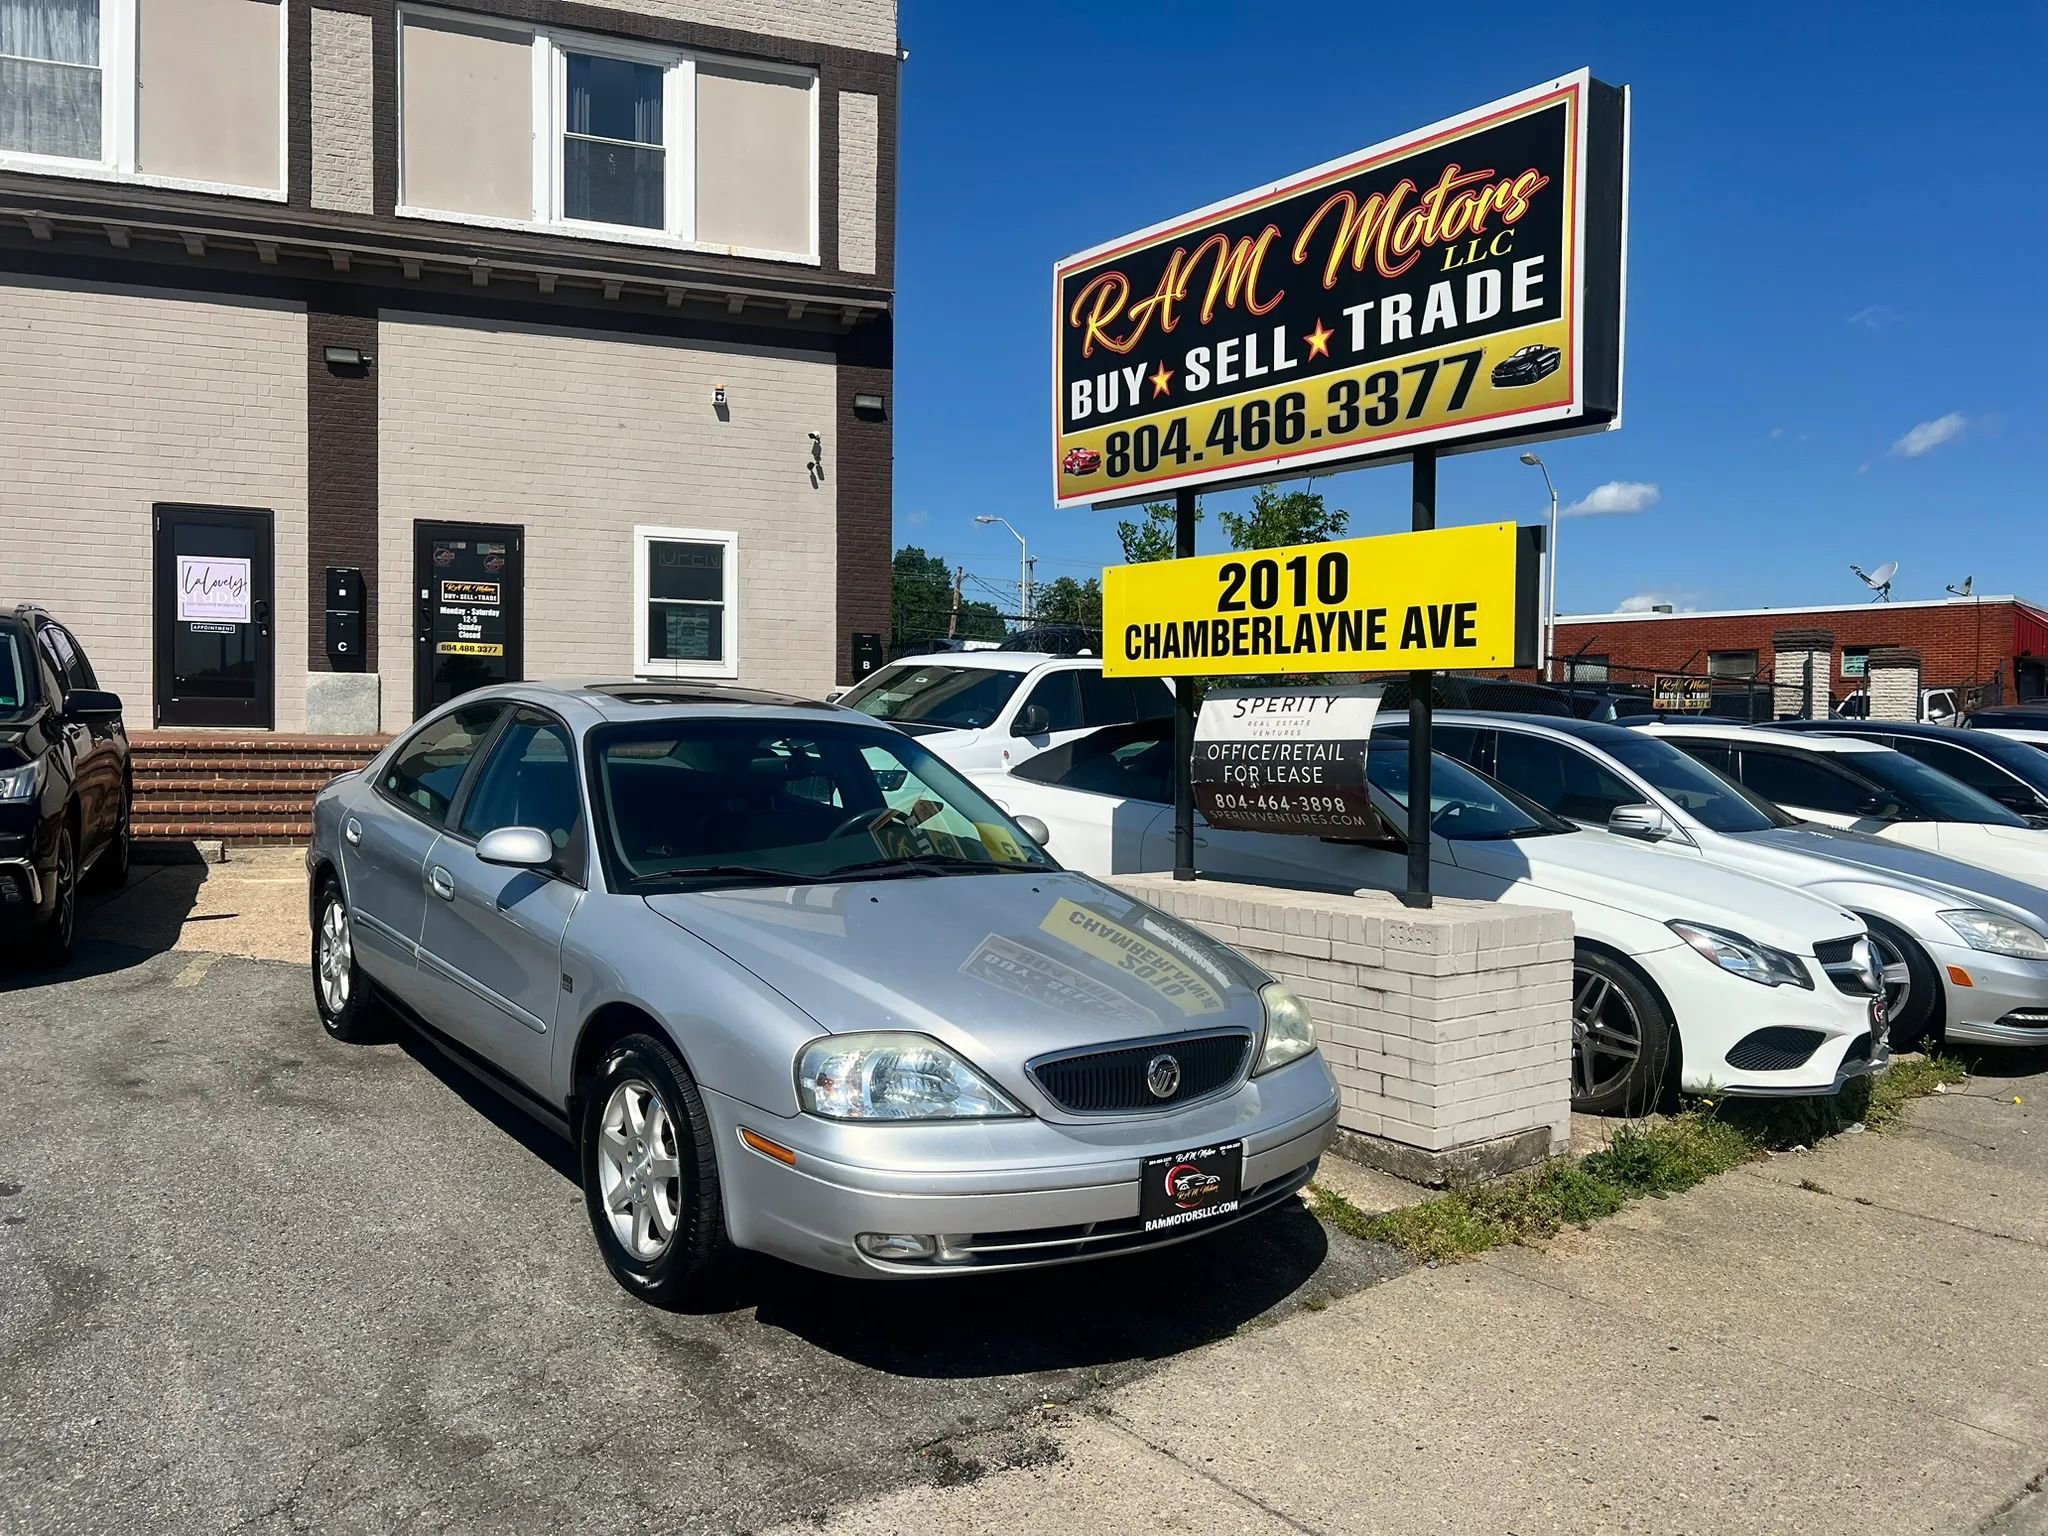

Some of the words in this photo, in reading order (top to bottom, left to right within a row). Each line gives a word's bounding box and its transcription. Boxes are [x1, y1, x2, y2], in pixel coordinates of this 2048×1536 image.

[1441, 229, 1515, 272] LLC
[1069, 223, 1285, 358] RAM
[1292, 163, 1549, 290] Motors
[1071, 362, 1149, 421] BUY
[1184, 325, 1297, 392] SELL
[1343, 254, 1545, 352] TRADE
[1105, 350, 1485, 479] 804.466.3377
[662, 547, 719, 566] OPEN
[1217, 551, 1349, 612] 2010
[440, 606, 465, 616] Monday
[471, 607, 500, 617] Saturday
[457, 623, 482, 632] Sunday
[458, 631, 481, 639] Closed
[1125, 608, 1387, 661] CHAMBERLAYNE
[1400, 602, 1477, 650] AVE
[338, 642, 347, 652] C
[863, 661, 870, 669] B
[1233, 695, 1339, 718] SPERITY
[1276, 719, 1311, 727] ESTATE
[1207, 743, 1345, 761] OFFICE/RETAIL
[1224, 765, 1261, 784] FOR
[1267, 765, 1323, 784] LEASE
[1215, 793, 1346, 813] 804-464-3898
[1209, 811, 1366, 826] SPERITYVENTURES.COM
